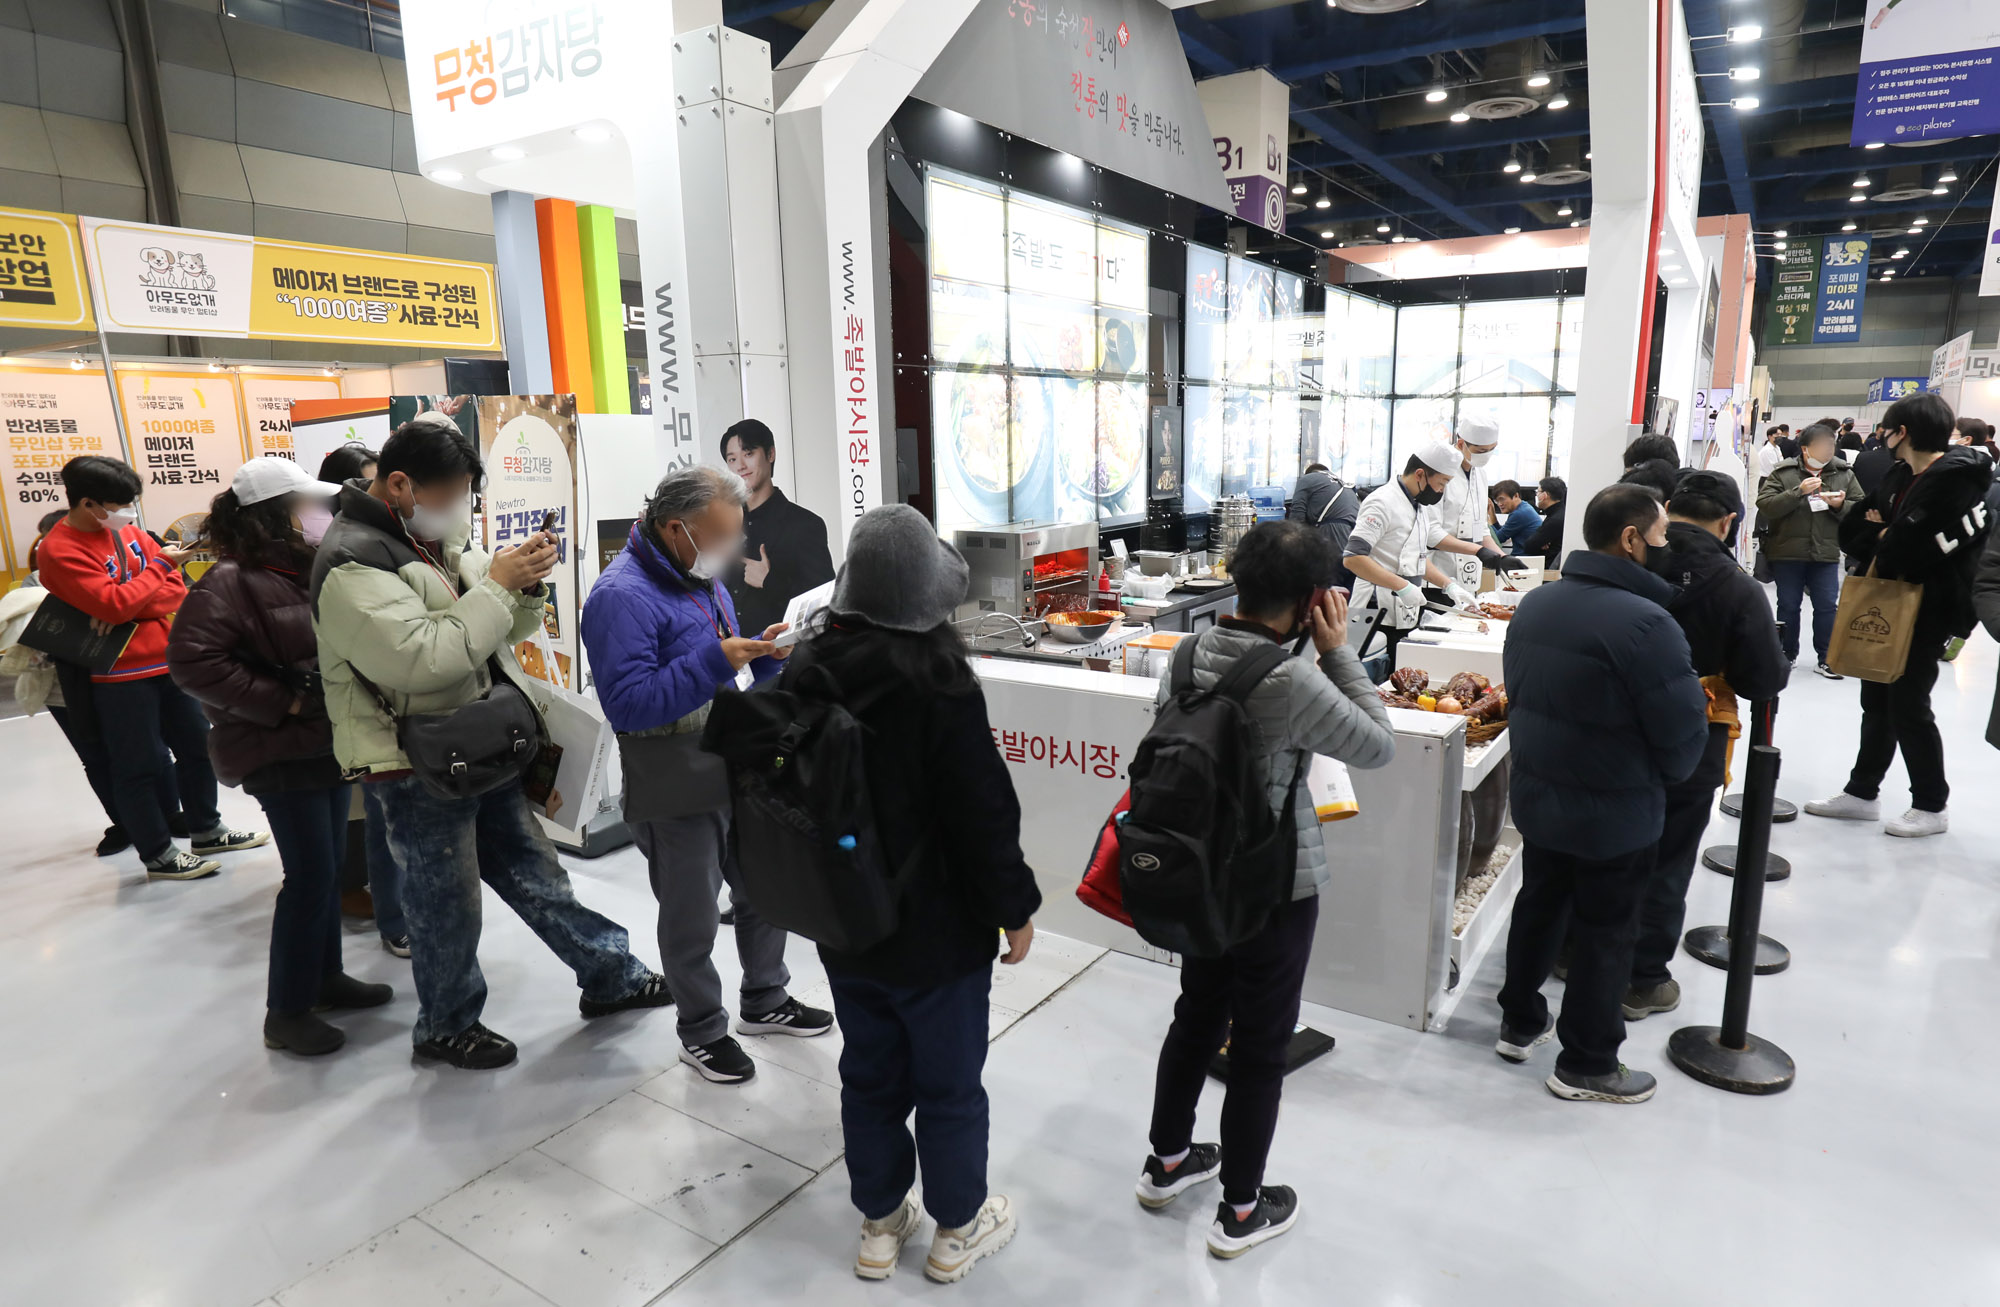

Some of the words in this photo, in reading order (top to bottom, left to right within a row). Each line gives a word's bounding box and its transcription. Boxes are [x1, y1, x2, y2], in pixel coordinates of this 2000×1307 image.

[433, 3, 604, 112] 무청감자탕
[1070, 70, 1109, 124] 전통의
[1116, 93, 1139, 136] 맛을
[1144, 111, 1185, 156] 만듭니다.
[1213, 136, 1243, 172] B1
[1267, 133, 1282, 175] B1
[1228, 183, 1246, 200] 전
[1011, 231, 1064, 269] 족발도
[1784, 248, 1812, 258] 대한민국
[271, 266, 338, 293] 메이저
[341, 273, 421, 300] 브랜드로
[423, 280, 478, 305] 구성된
[1826, 283, 1859, 295] 마이펫
[145, 288, 217, 307] 아무도없개
[1776, 291, 1811, 301] 스터디카페
[148, 305, 179, 315] 반려동물
[180, 306, 195, 315] 무인
[196, 307, 218, 317] 멀티샵
[1775, 304, 1794, 314] 대상
[1795, 303, 1810, 313] 1위
[1825, 298, 1855, 311] 24시
[6, 418, 79, 434] 반려동물
[141, 419, 216, 434] 1000여종
[259, 419, 292, 433] 24시
[9, 437, 63, 451] 무인샵
[68, 436, 104, 451] 유일
[144, 436, 195, 451] 메이저
[261, 435, 294, 449] 철통
[147, 453, 198, 468] 브랜드
[503, 456, 553, 474] 무청감자탕
[19, 489, 60, 503] 80%
[495, 498, 526, 511] Newtro
